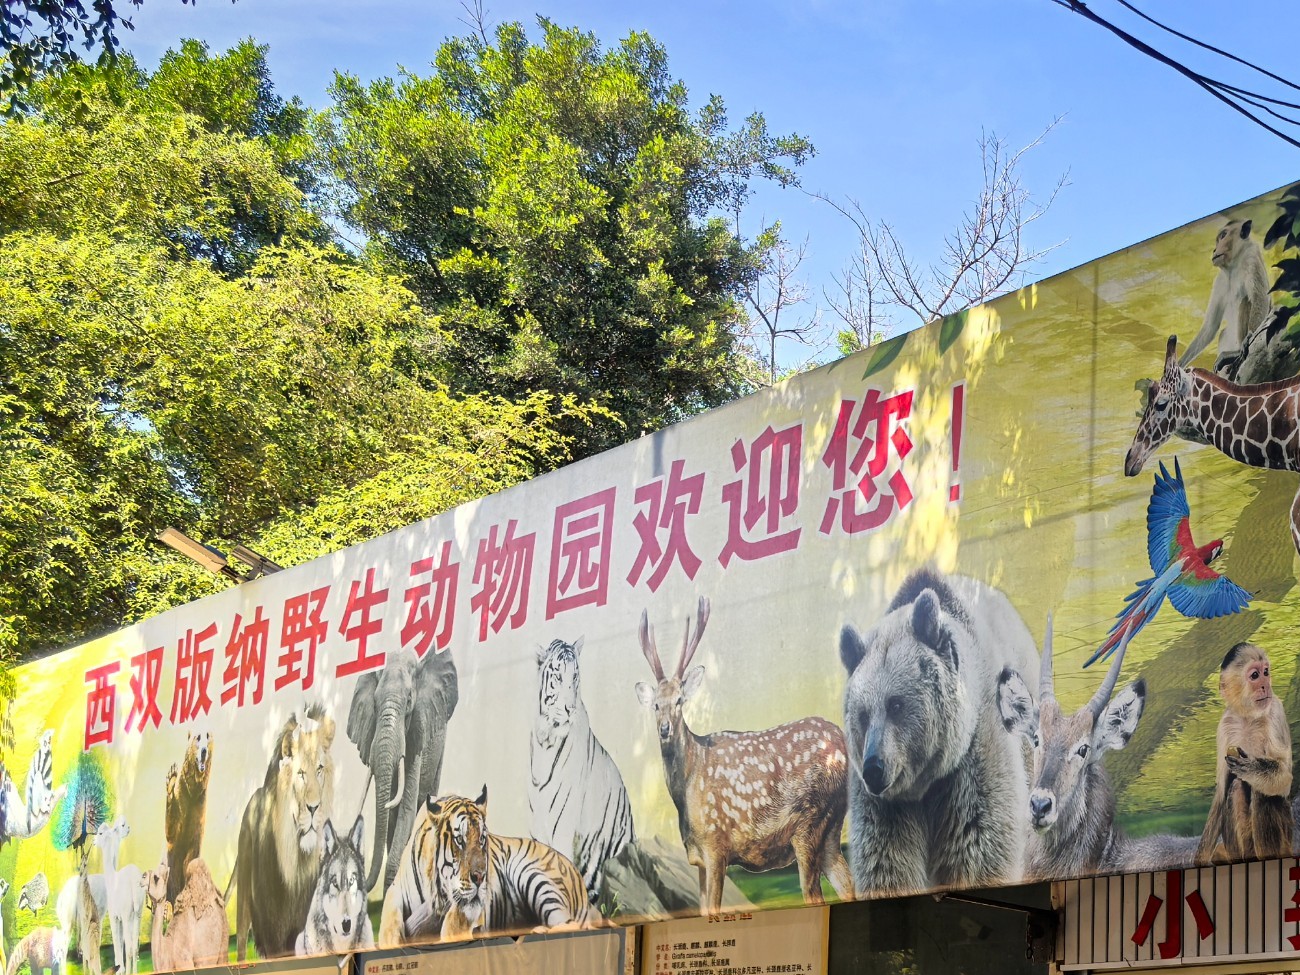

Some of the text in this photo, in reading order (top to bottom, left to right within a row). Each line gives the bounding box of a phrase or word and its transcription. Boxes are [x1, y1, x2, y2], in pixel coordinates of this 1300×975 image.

[82, 383, 965, 752] 西双版纳野生动物园欢迎您！
